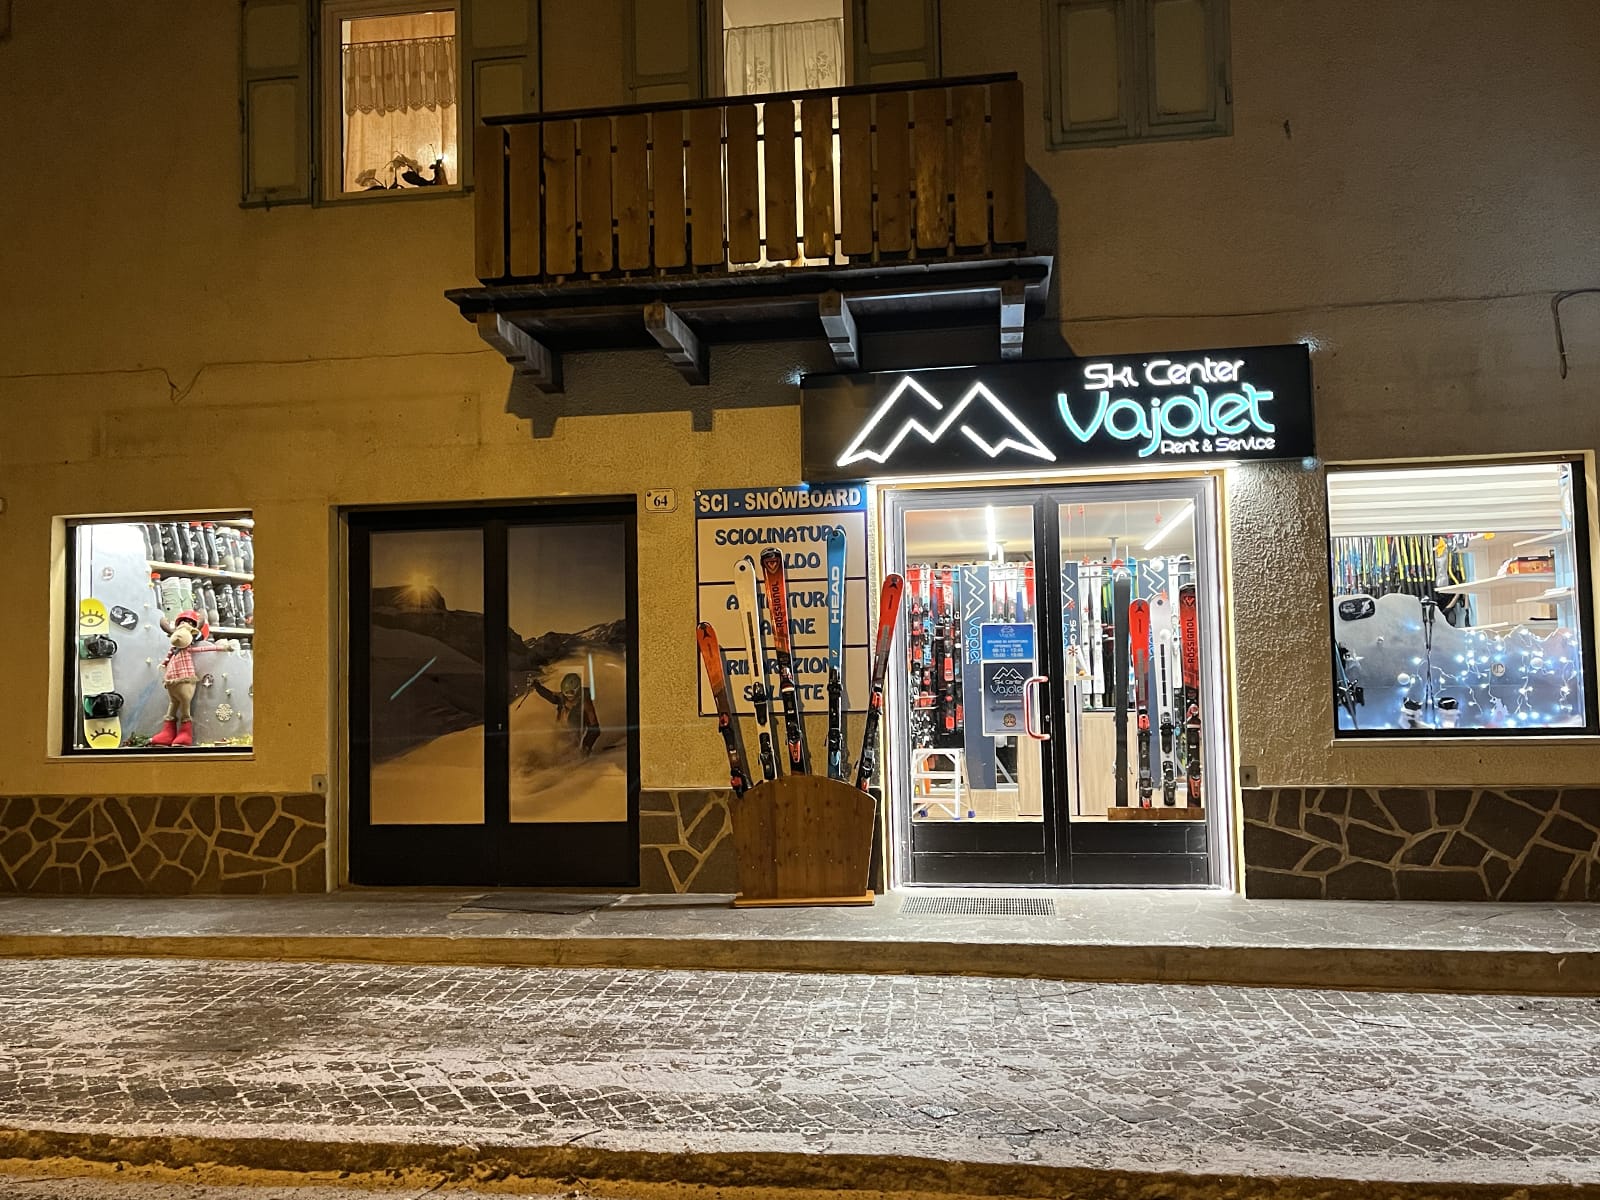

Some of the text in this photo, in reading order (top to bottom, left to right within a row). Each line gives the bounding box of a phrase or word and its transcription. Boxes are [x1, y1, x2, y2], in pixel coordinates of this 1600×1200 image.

[1084, 357, 1245, 389] Ski Center
[1057, 382, 1276, 458] Vajolet
[1161, 437, 1276, 455] Rent & Service
[653, 495, 668, 507] 64
[699, 493, 729, 513] SCI
[744, 488, 862, 511] SNOWBOARD
[831, 566, 840, 624] HEAD
[1186, 617, 1195, 664] ROSSIGNOL
[990, 684, 1026, 697] Vajole
